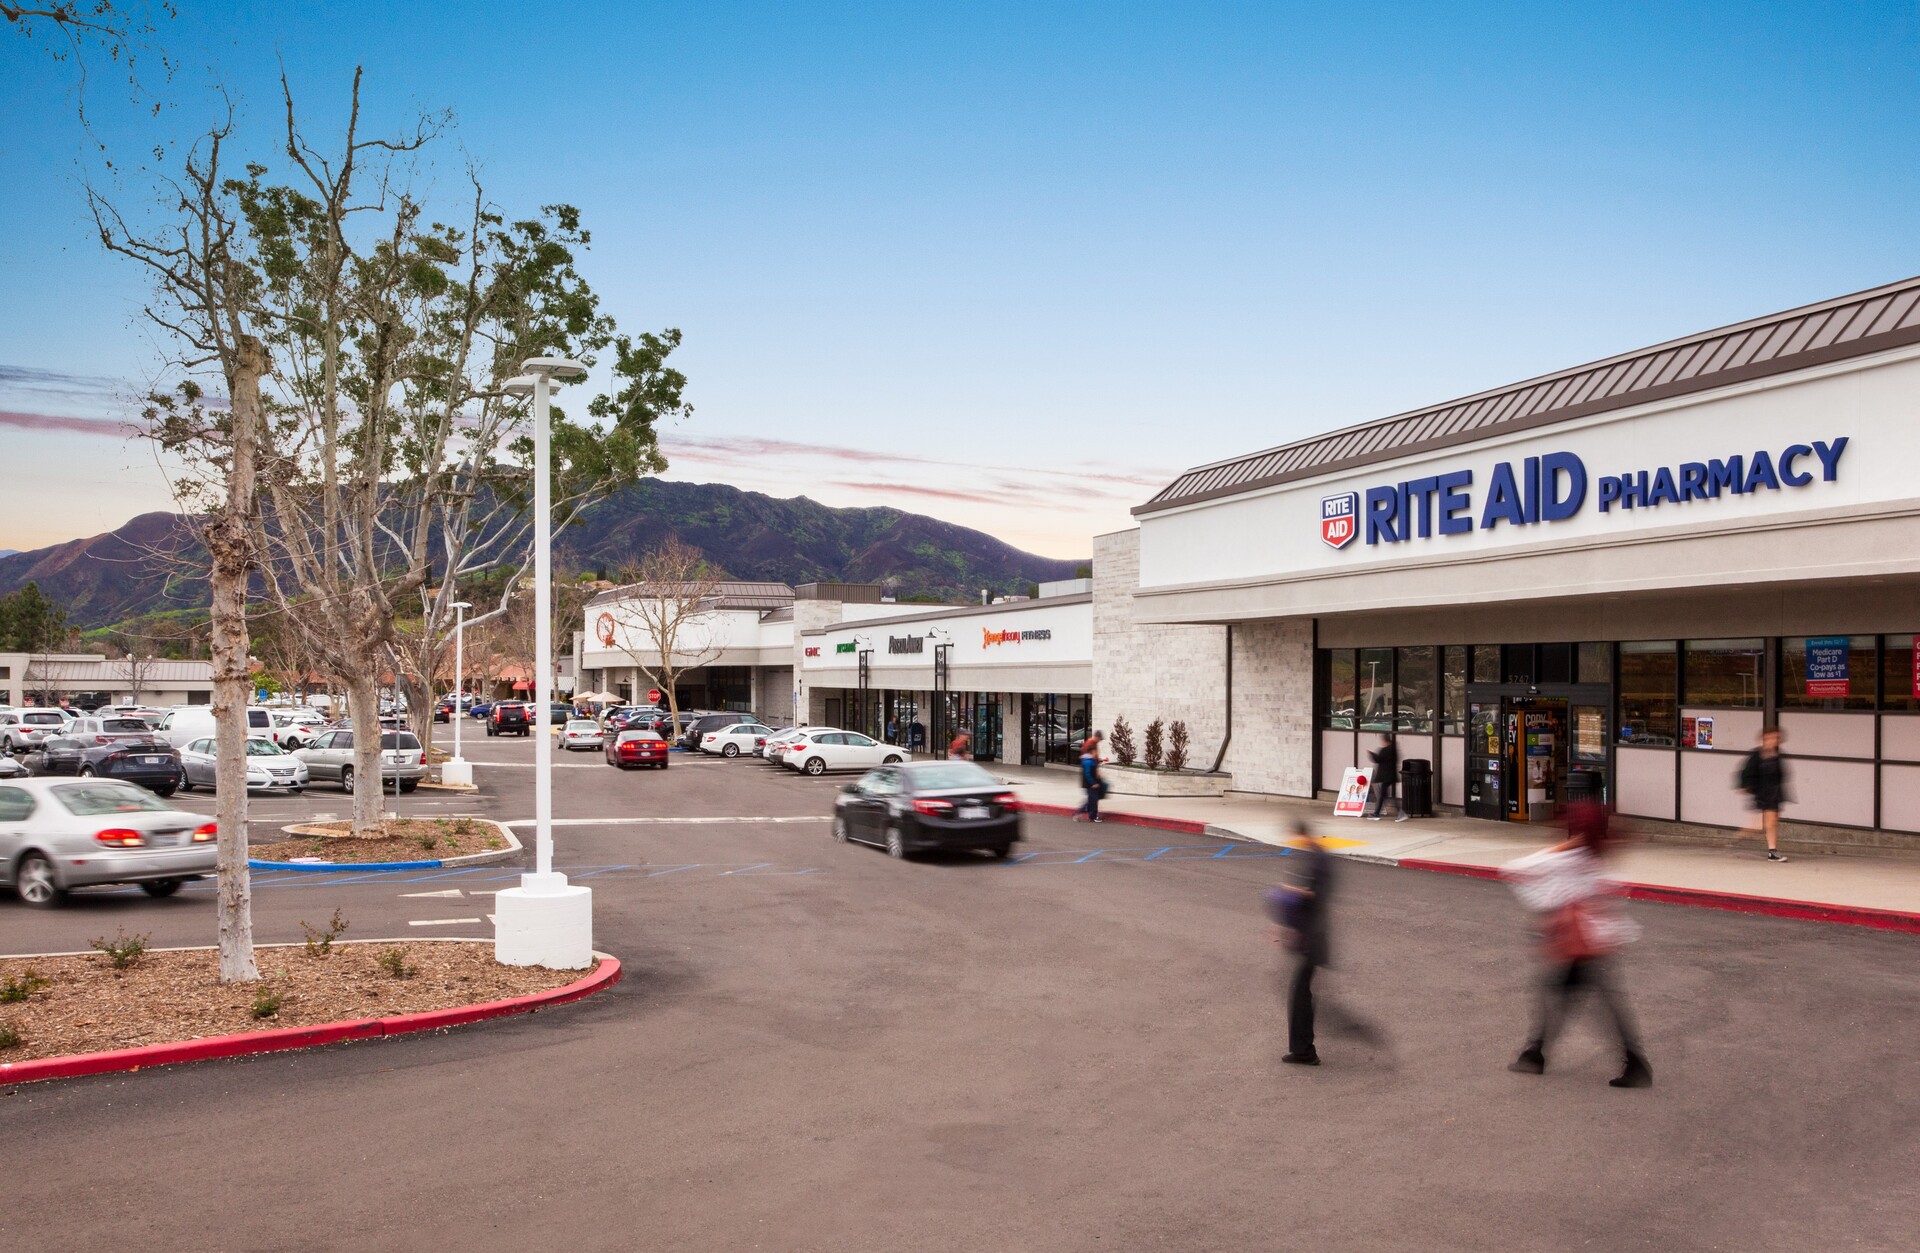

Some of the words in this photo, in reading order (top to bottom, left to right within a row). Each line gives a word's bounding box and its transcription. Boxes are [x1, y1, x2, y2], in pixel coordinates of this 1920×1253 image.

[1366, 469, 1473, 545] RITE
[1480, 451, 1587, 529] AID
[1599, 437, 1849, 513] PHARMACY
[1325, 497, 1350, 516] RITE
[1327, 520, 1348, 539] AID
[1021, 629, 1051, 641] FITNESS
[805, 647, 820, 657] GNC
